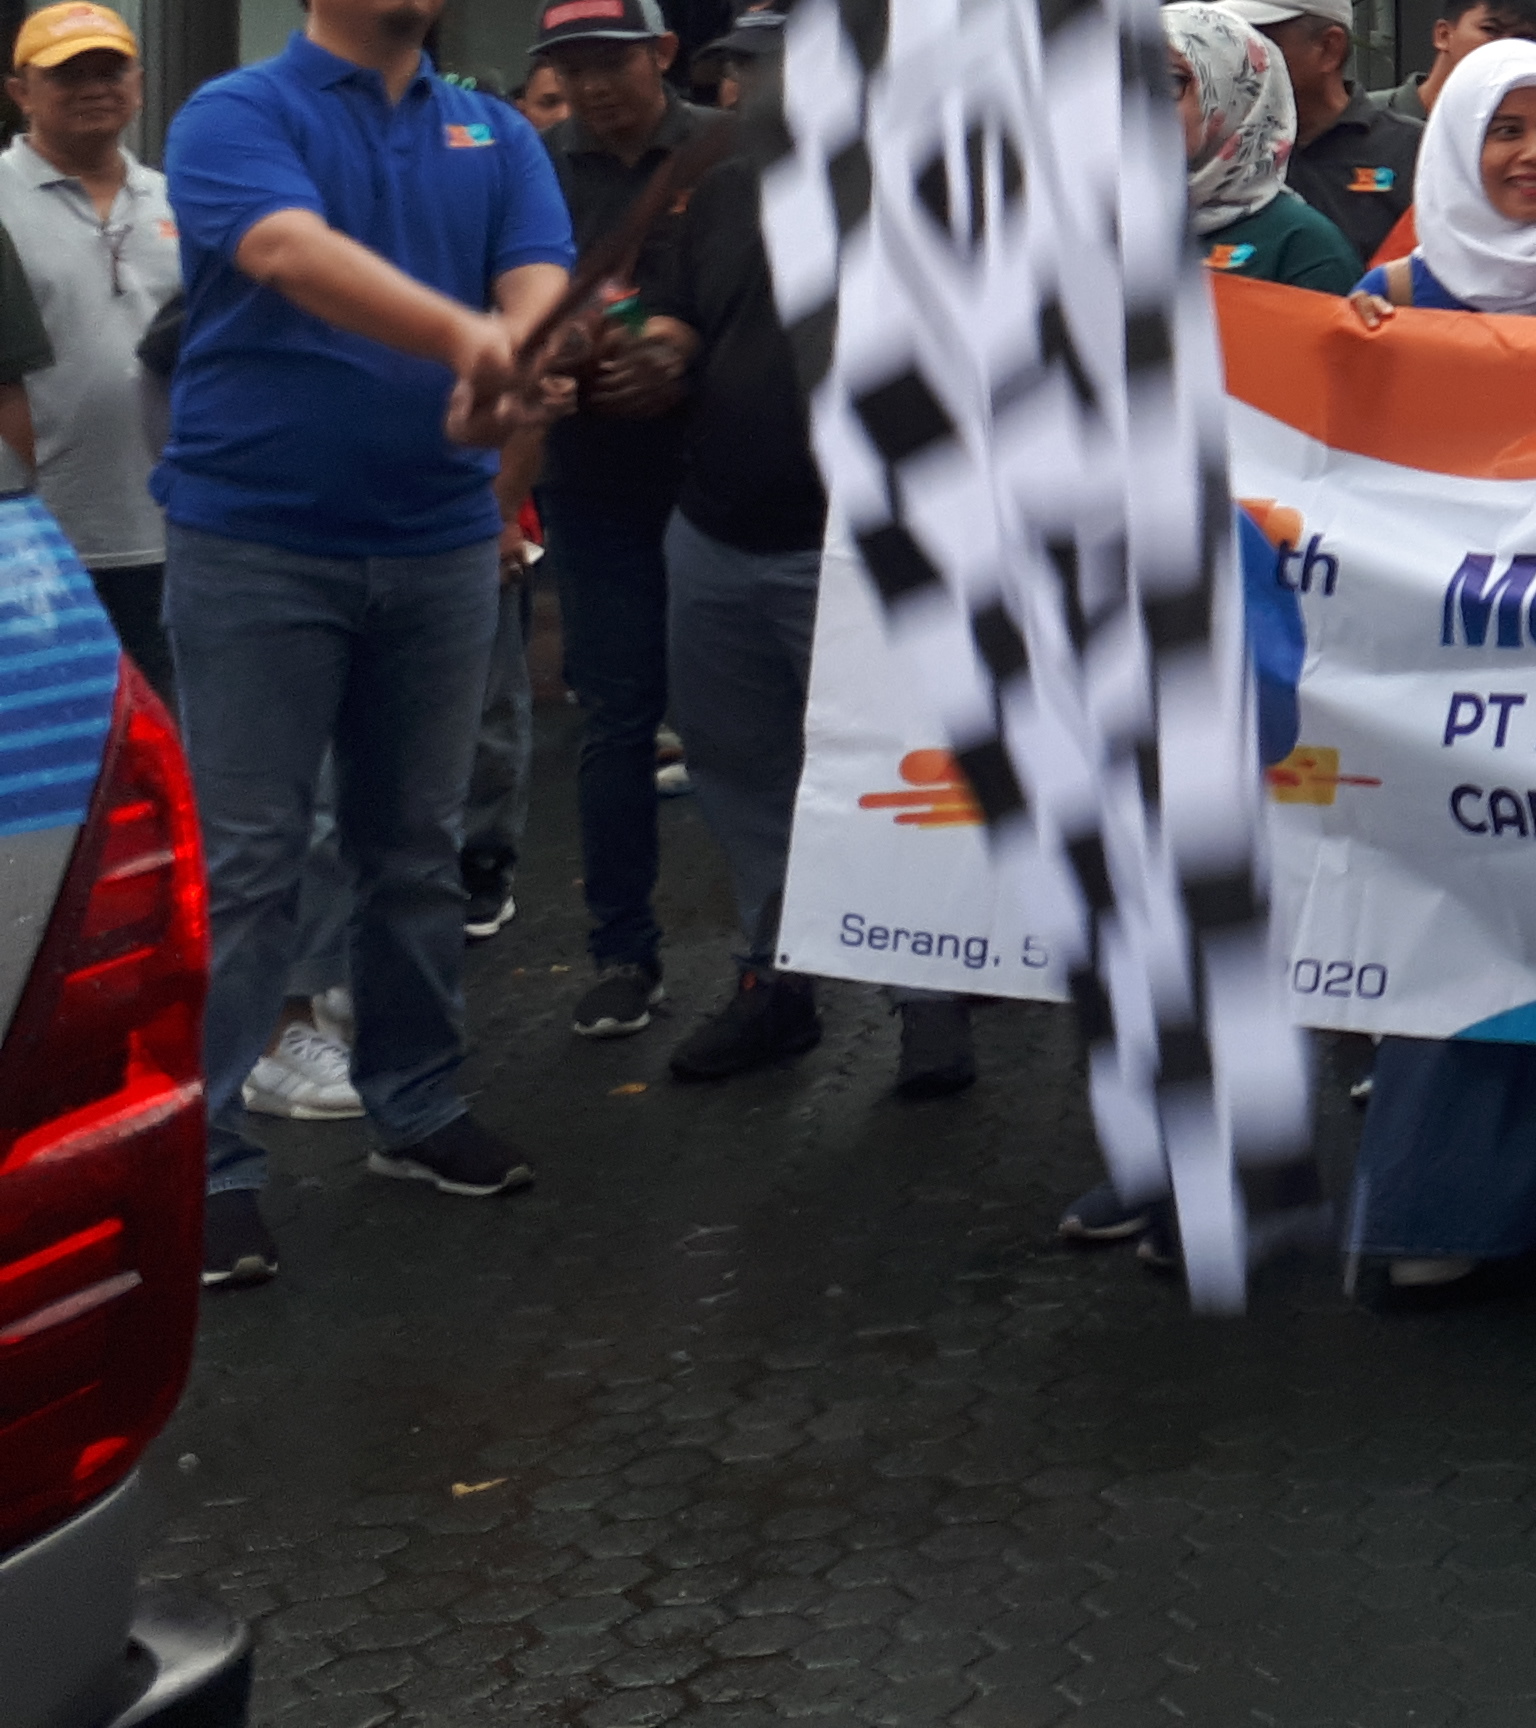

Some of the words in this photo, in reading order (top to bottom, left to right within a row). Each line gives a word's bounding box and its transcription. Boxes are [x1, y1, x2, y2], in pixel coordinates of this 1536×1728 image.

[1441, 693, 1527, 748] PT
[840, 913, 1001, 968] Serang,
[1022, 936, 1049, 968] 5
[1284, 958, 1389, 1000] 020
